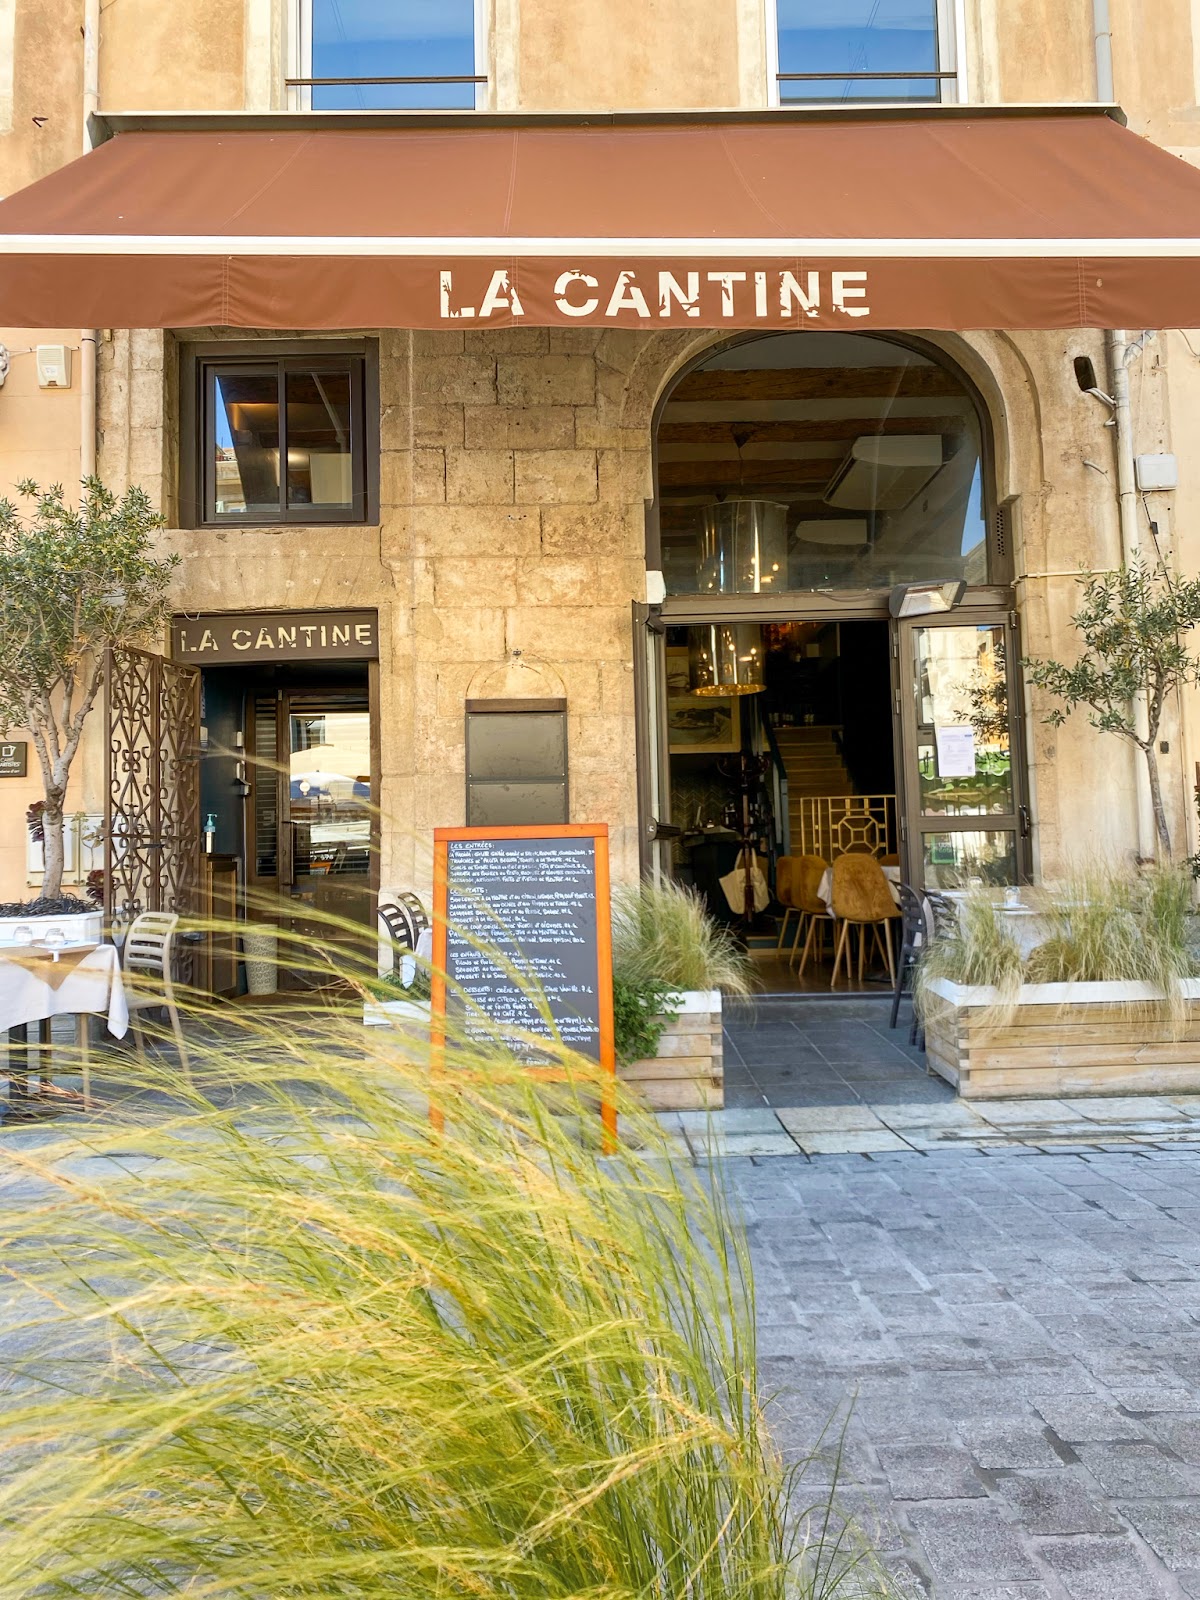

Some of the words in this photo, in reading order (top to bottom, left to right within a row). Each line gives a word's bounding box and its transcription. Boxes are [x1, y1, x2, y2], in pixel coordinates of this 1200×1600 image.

[439, 269, 525, 318] LA
[553, 268, 870, 318] CANTINE
[180, 629, 219, 652] LA
[231, 624, 372, 650] CANTINE
